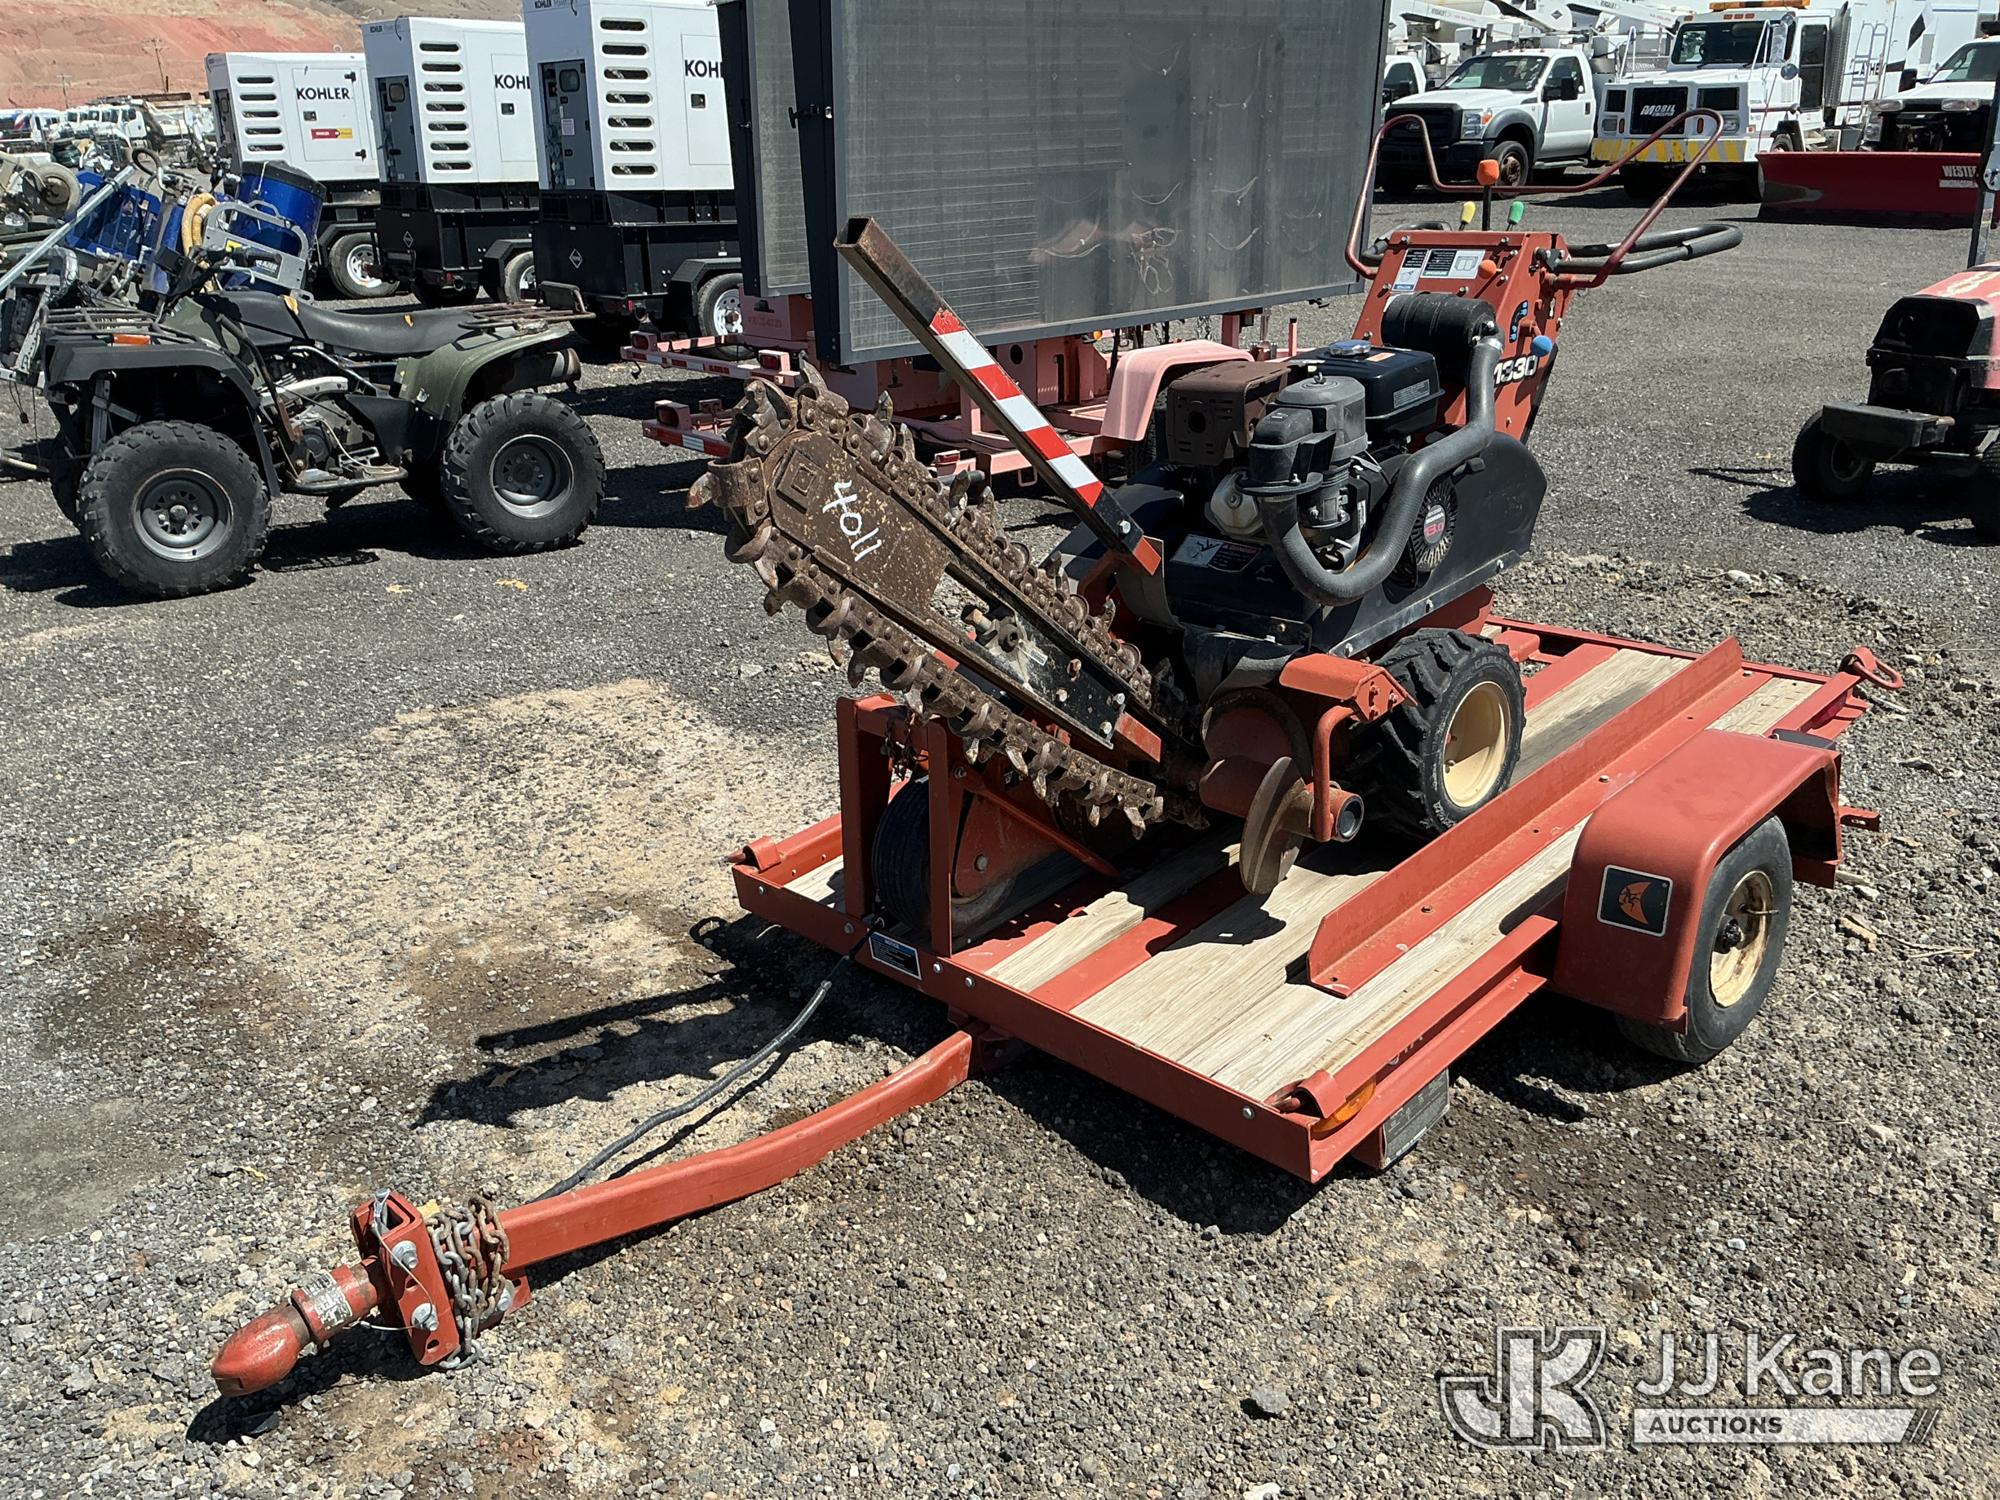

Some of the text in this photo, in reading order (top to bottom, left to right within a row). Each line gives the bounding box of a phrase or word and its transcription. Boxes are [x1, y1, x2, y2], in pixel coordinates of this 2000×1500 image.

[296, 87, 351, 100] KOHLER
[1640, 104, 1676, 117] MOBIL
[1493, 354, 1538, 385] 1330
[822, 480, 882, 562] 4011
